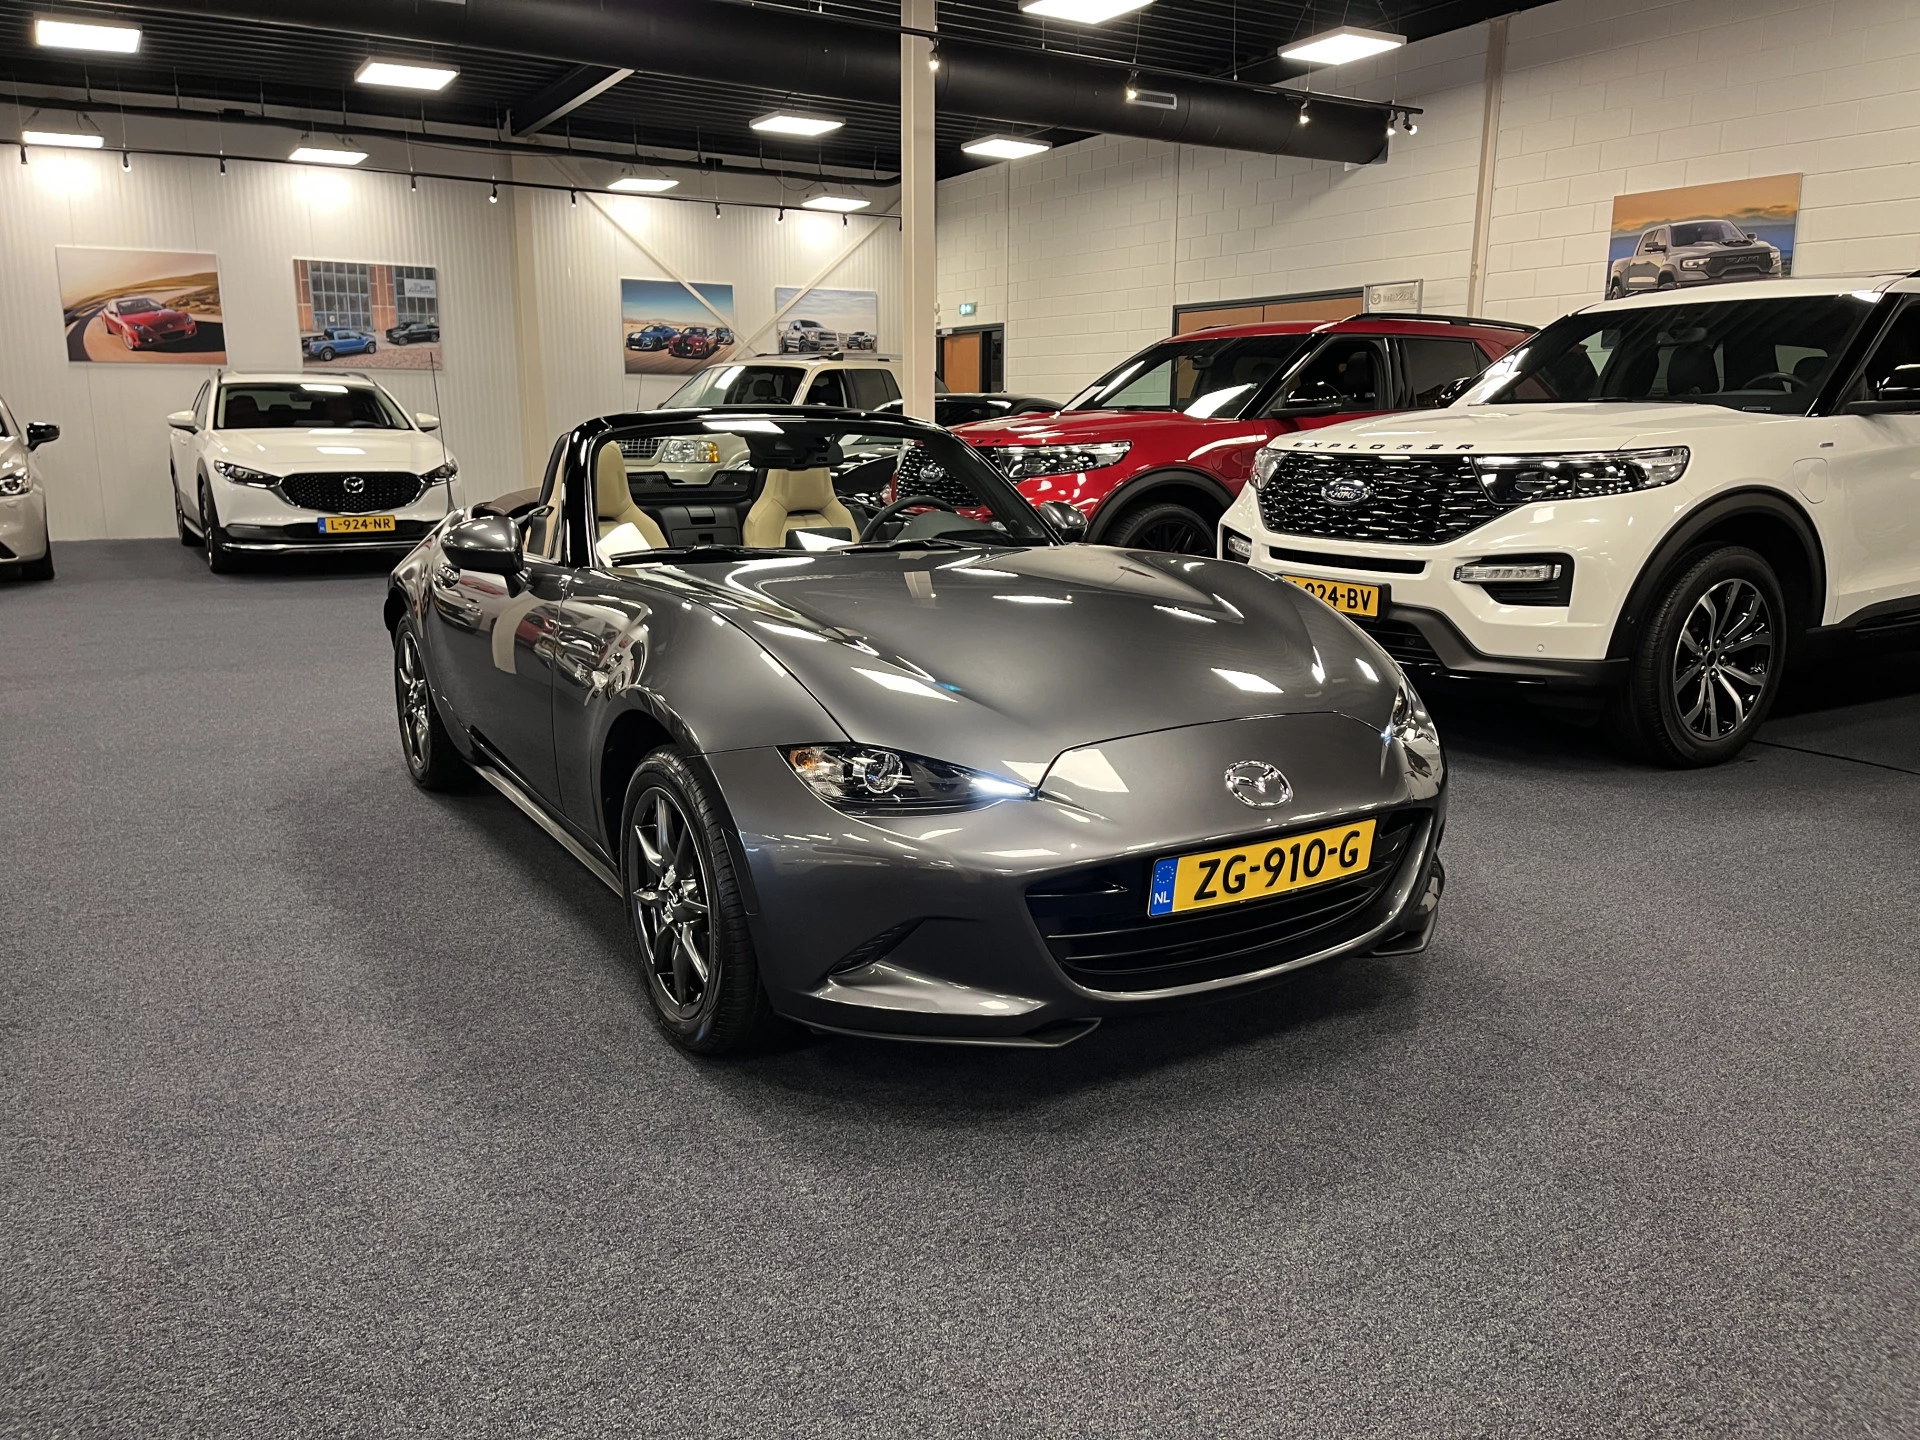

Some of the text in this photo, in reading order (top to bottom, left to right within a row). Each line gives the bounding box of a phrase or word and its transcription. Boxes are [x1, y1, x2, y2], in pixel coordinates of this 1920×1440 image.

[1293, 442, 1474, 450] EXPLORER
[330, 518, 391, 531] L-924-NR
[1194, 830, 1361, 901] ZG-910-G
[1154, 891, 1171, 905] NL
